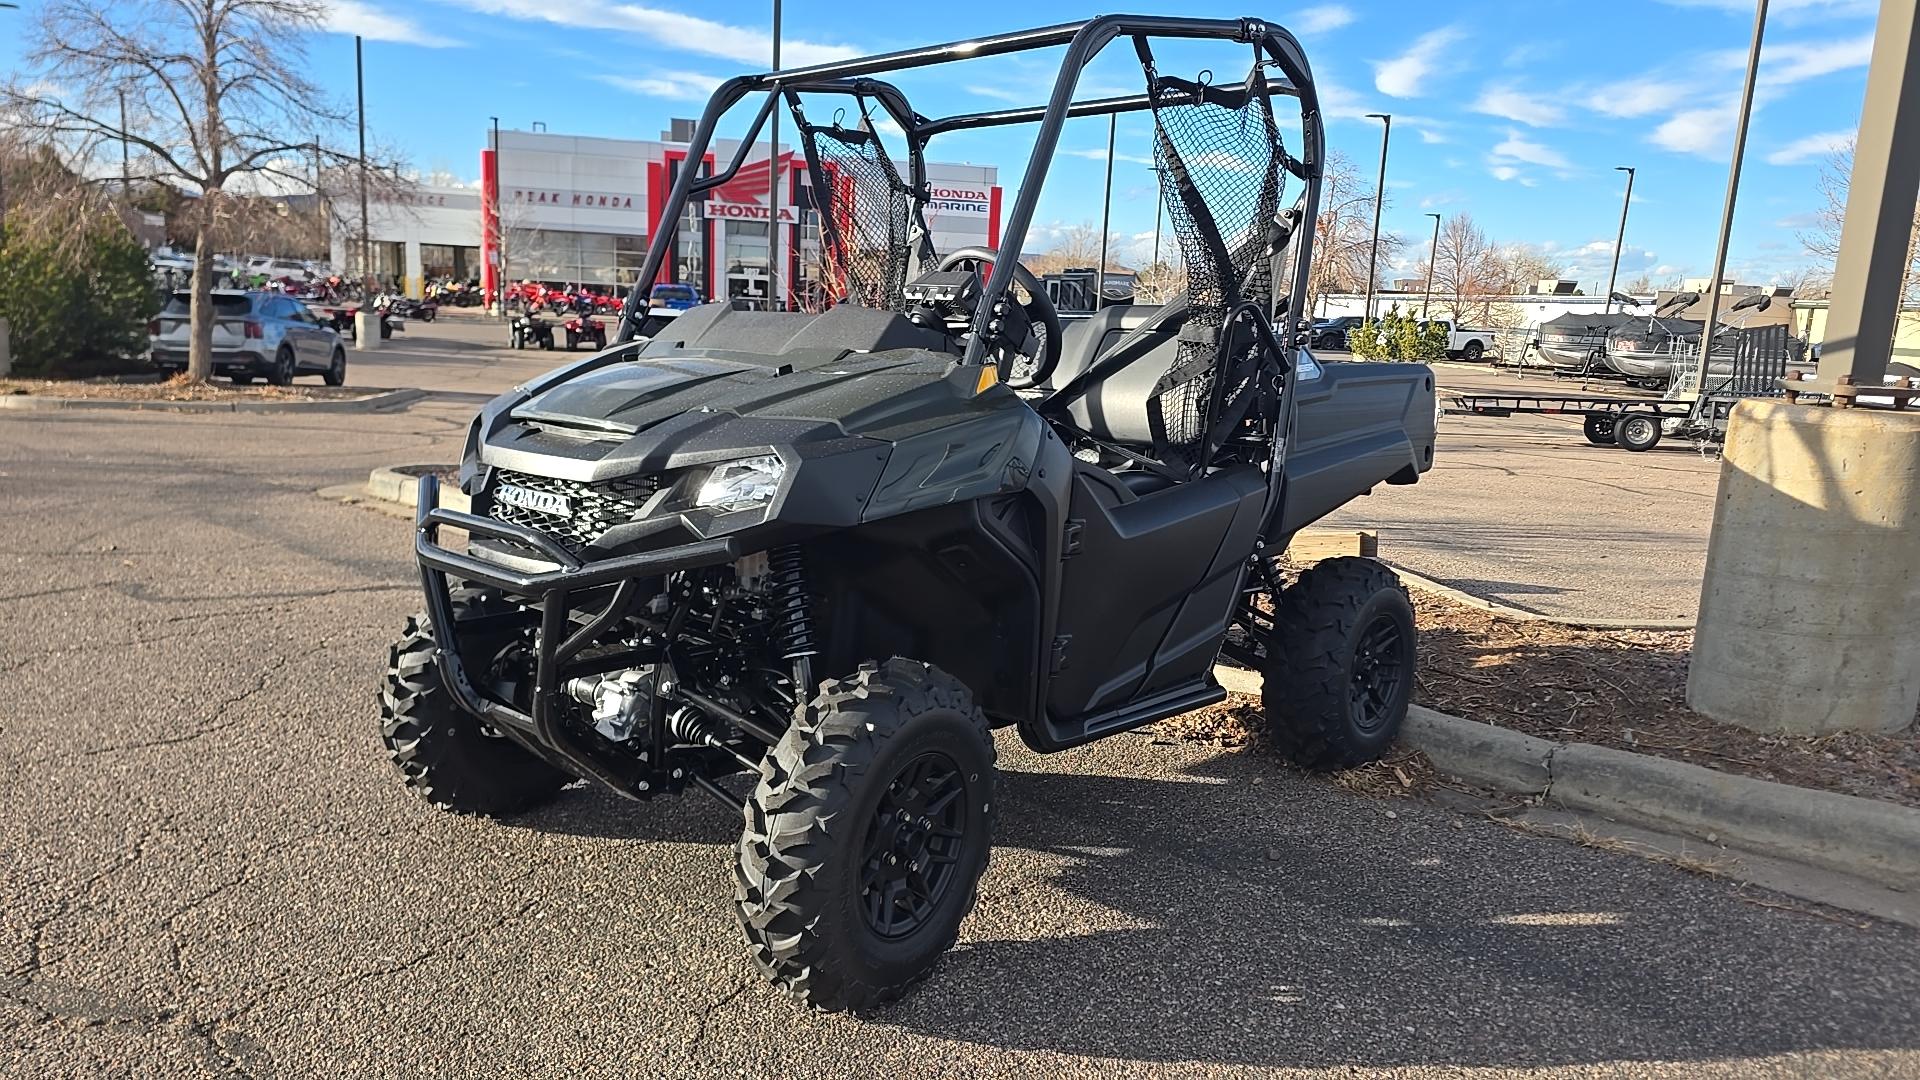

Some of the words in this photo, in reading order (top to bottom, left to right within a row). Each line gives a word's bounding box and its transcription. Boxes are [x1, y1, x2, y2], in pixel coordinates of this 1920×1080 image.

[514, 190, 560, 204] PEAK
[572, 194, 632, 209] HONDA
[925, 188, 989, 201] HONDA
[926, 201, 989, 213] MARINE
[499, 484, 572, 519] HONDA
